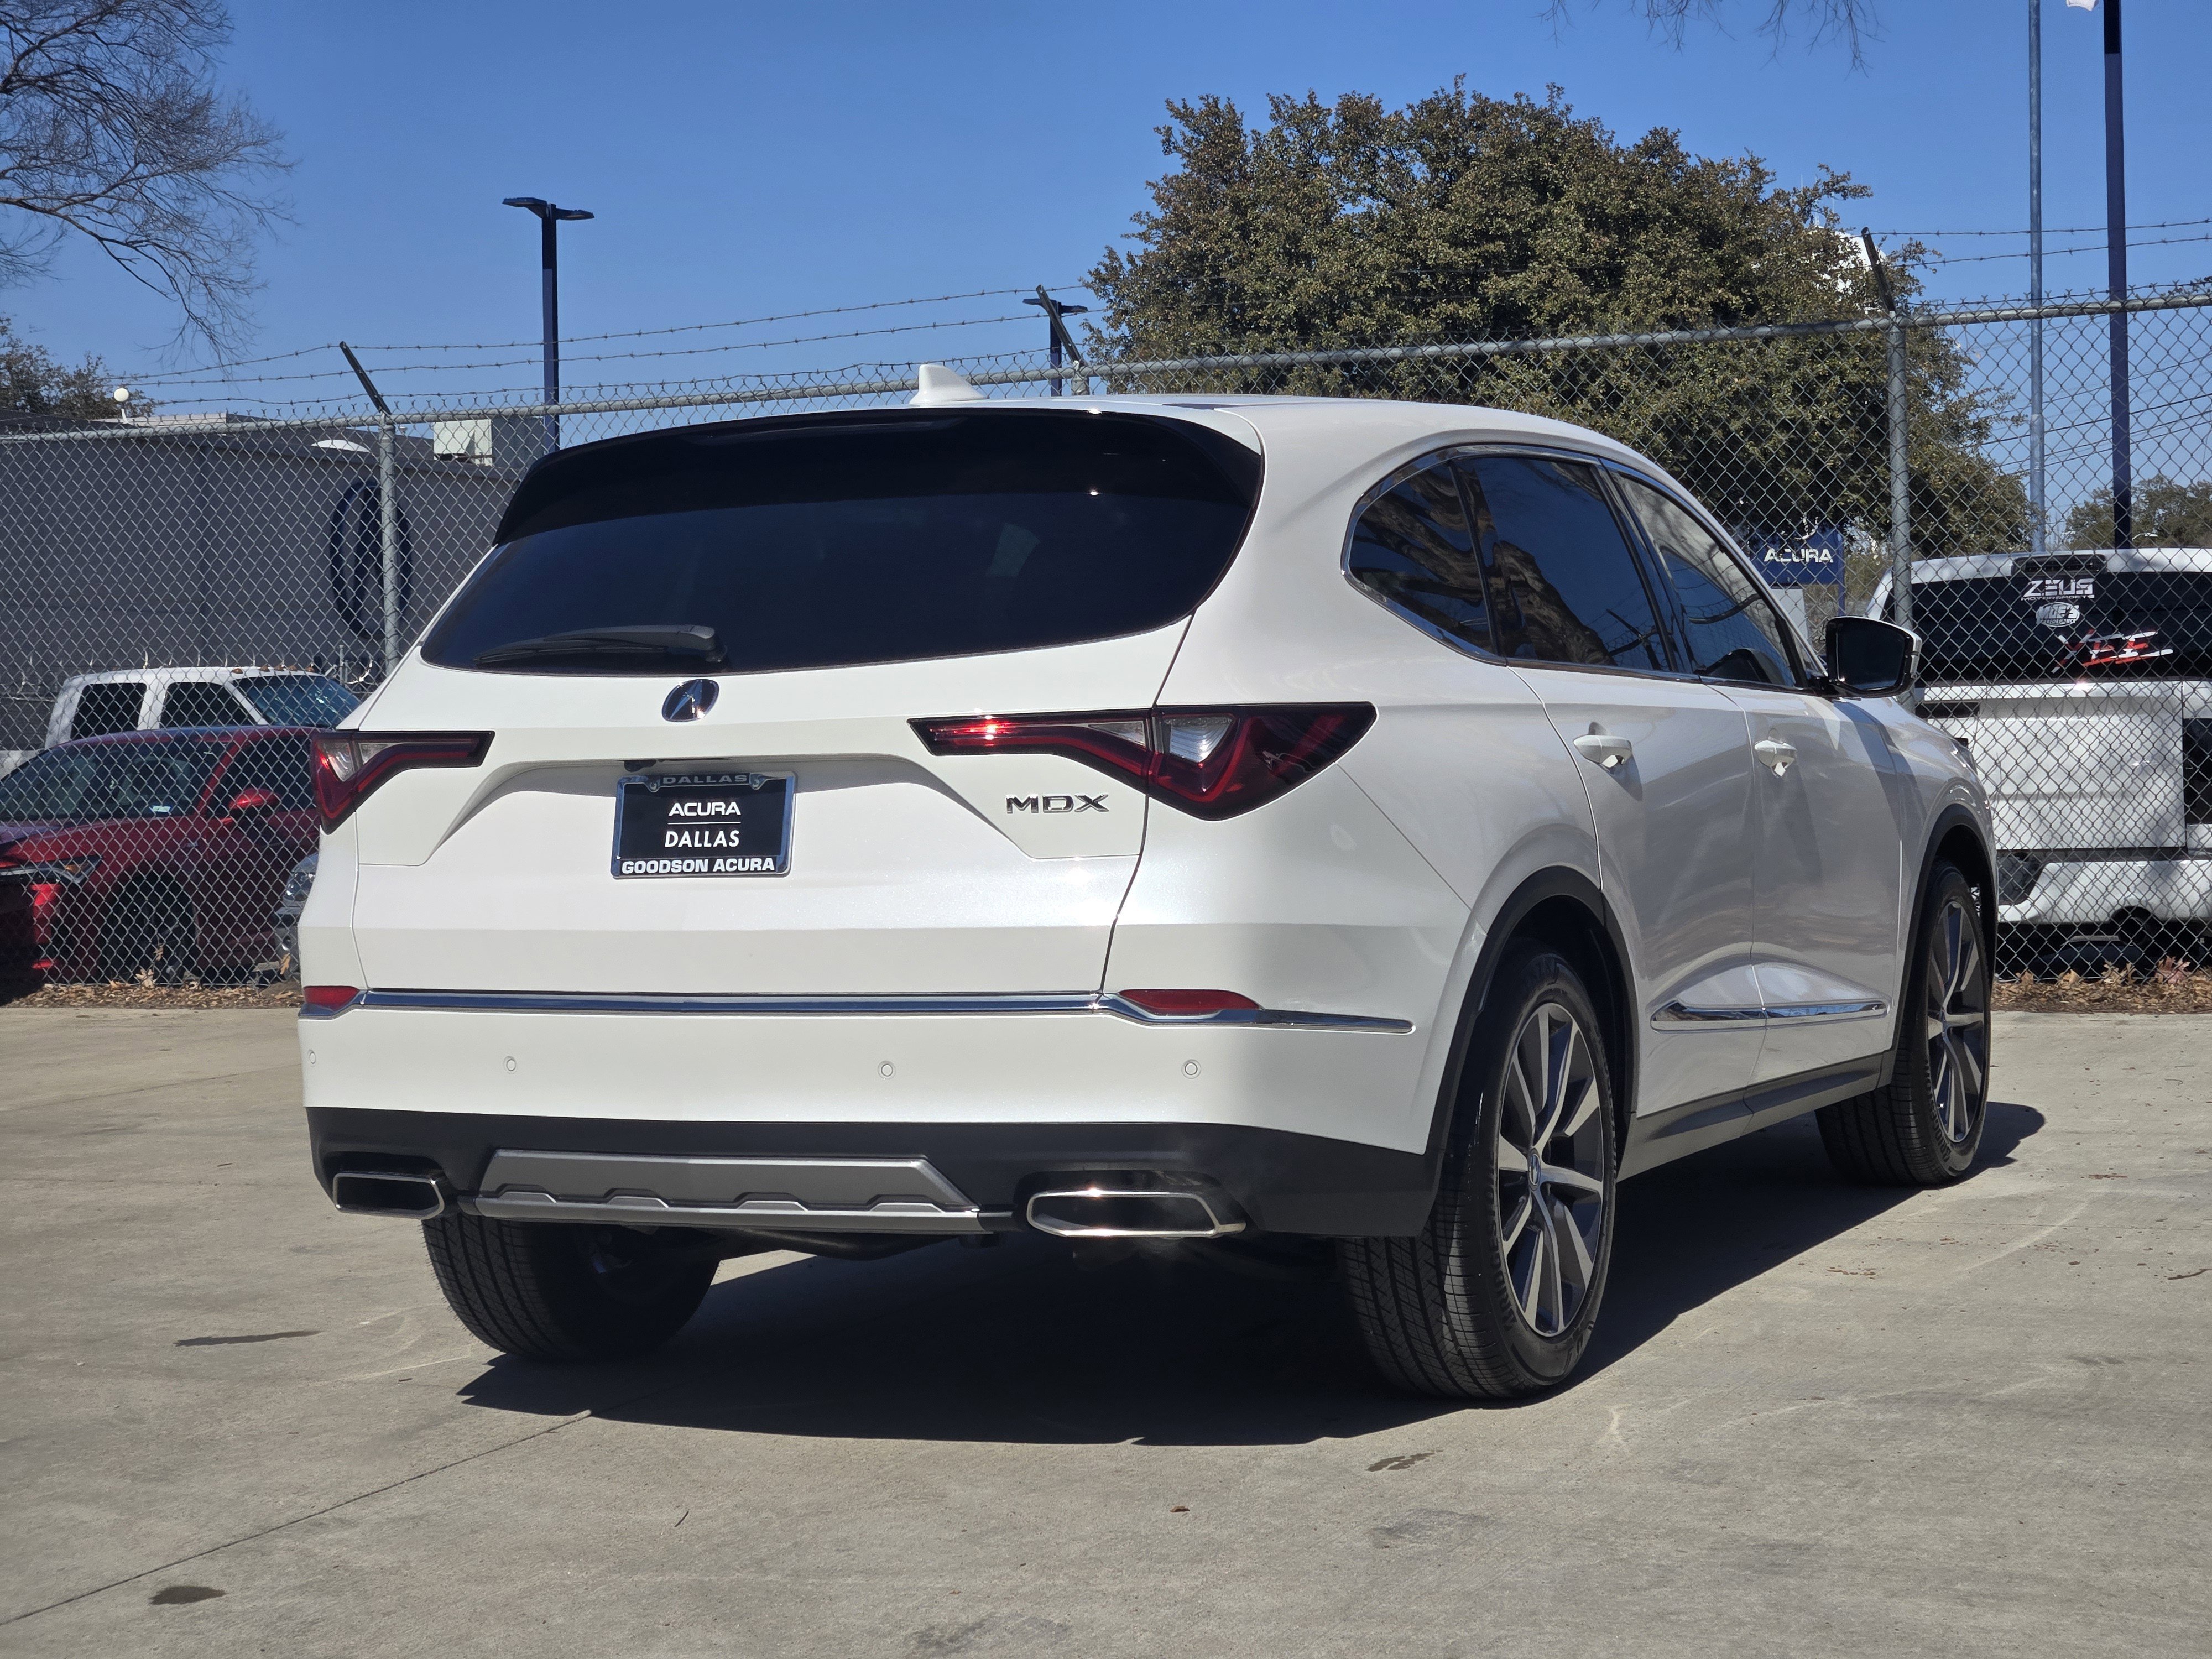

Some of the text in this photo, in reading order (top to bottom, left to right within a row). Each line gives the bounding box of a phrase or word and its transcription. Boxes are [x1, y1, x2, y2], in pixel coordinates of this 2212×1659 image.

[2023, 578, 2095, 597] ZEUS
[663, 775, 747, 784] DALLAS
[668, 802, 741, 816] ACURA
[1006, 794, 1109, 814] MDX
[665, 830, 740, 848] DALLAS
[622, 858, 775, 874] GOODSON ACURA
